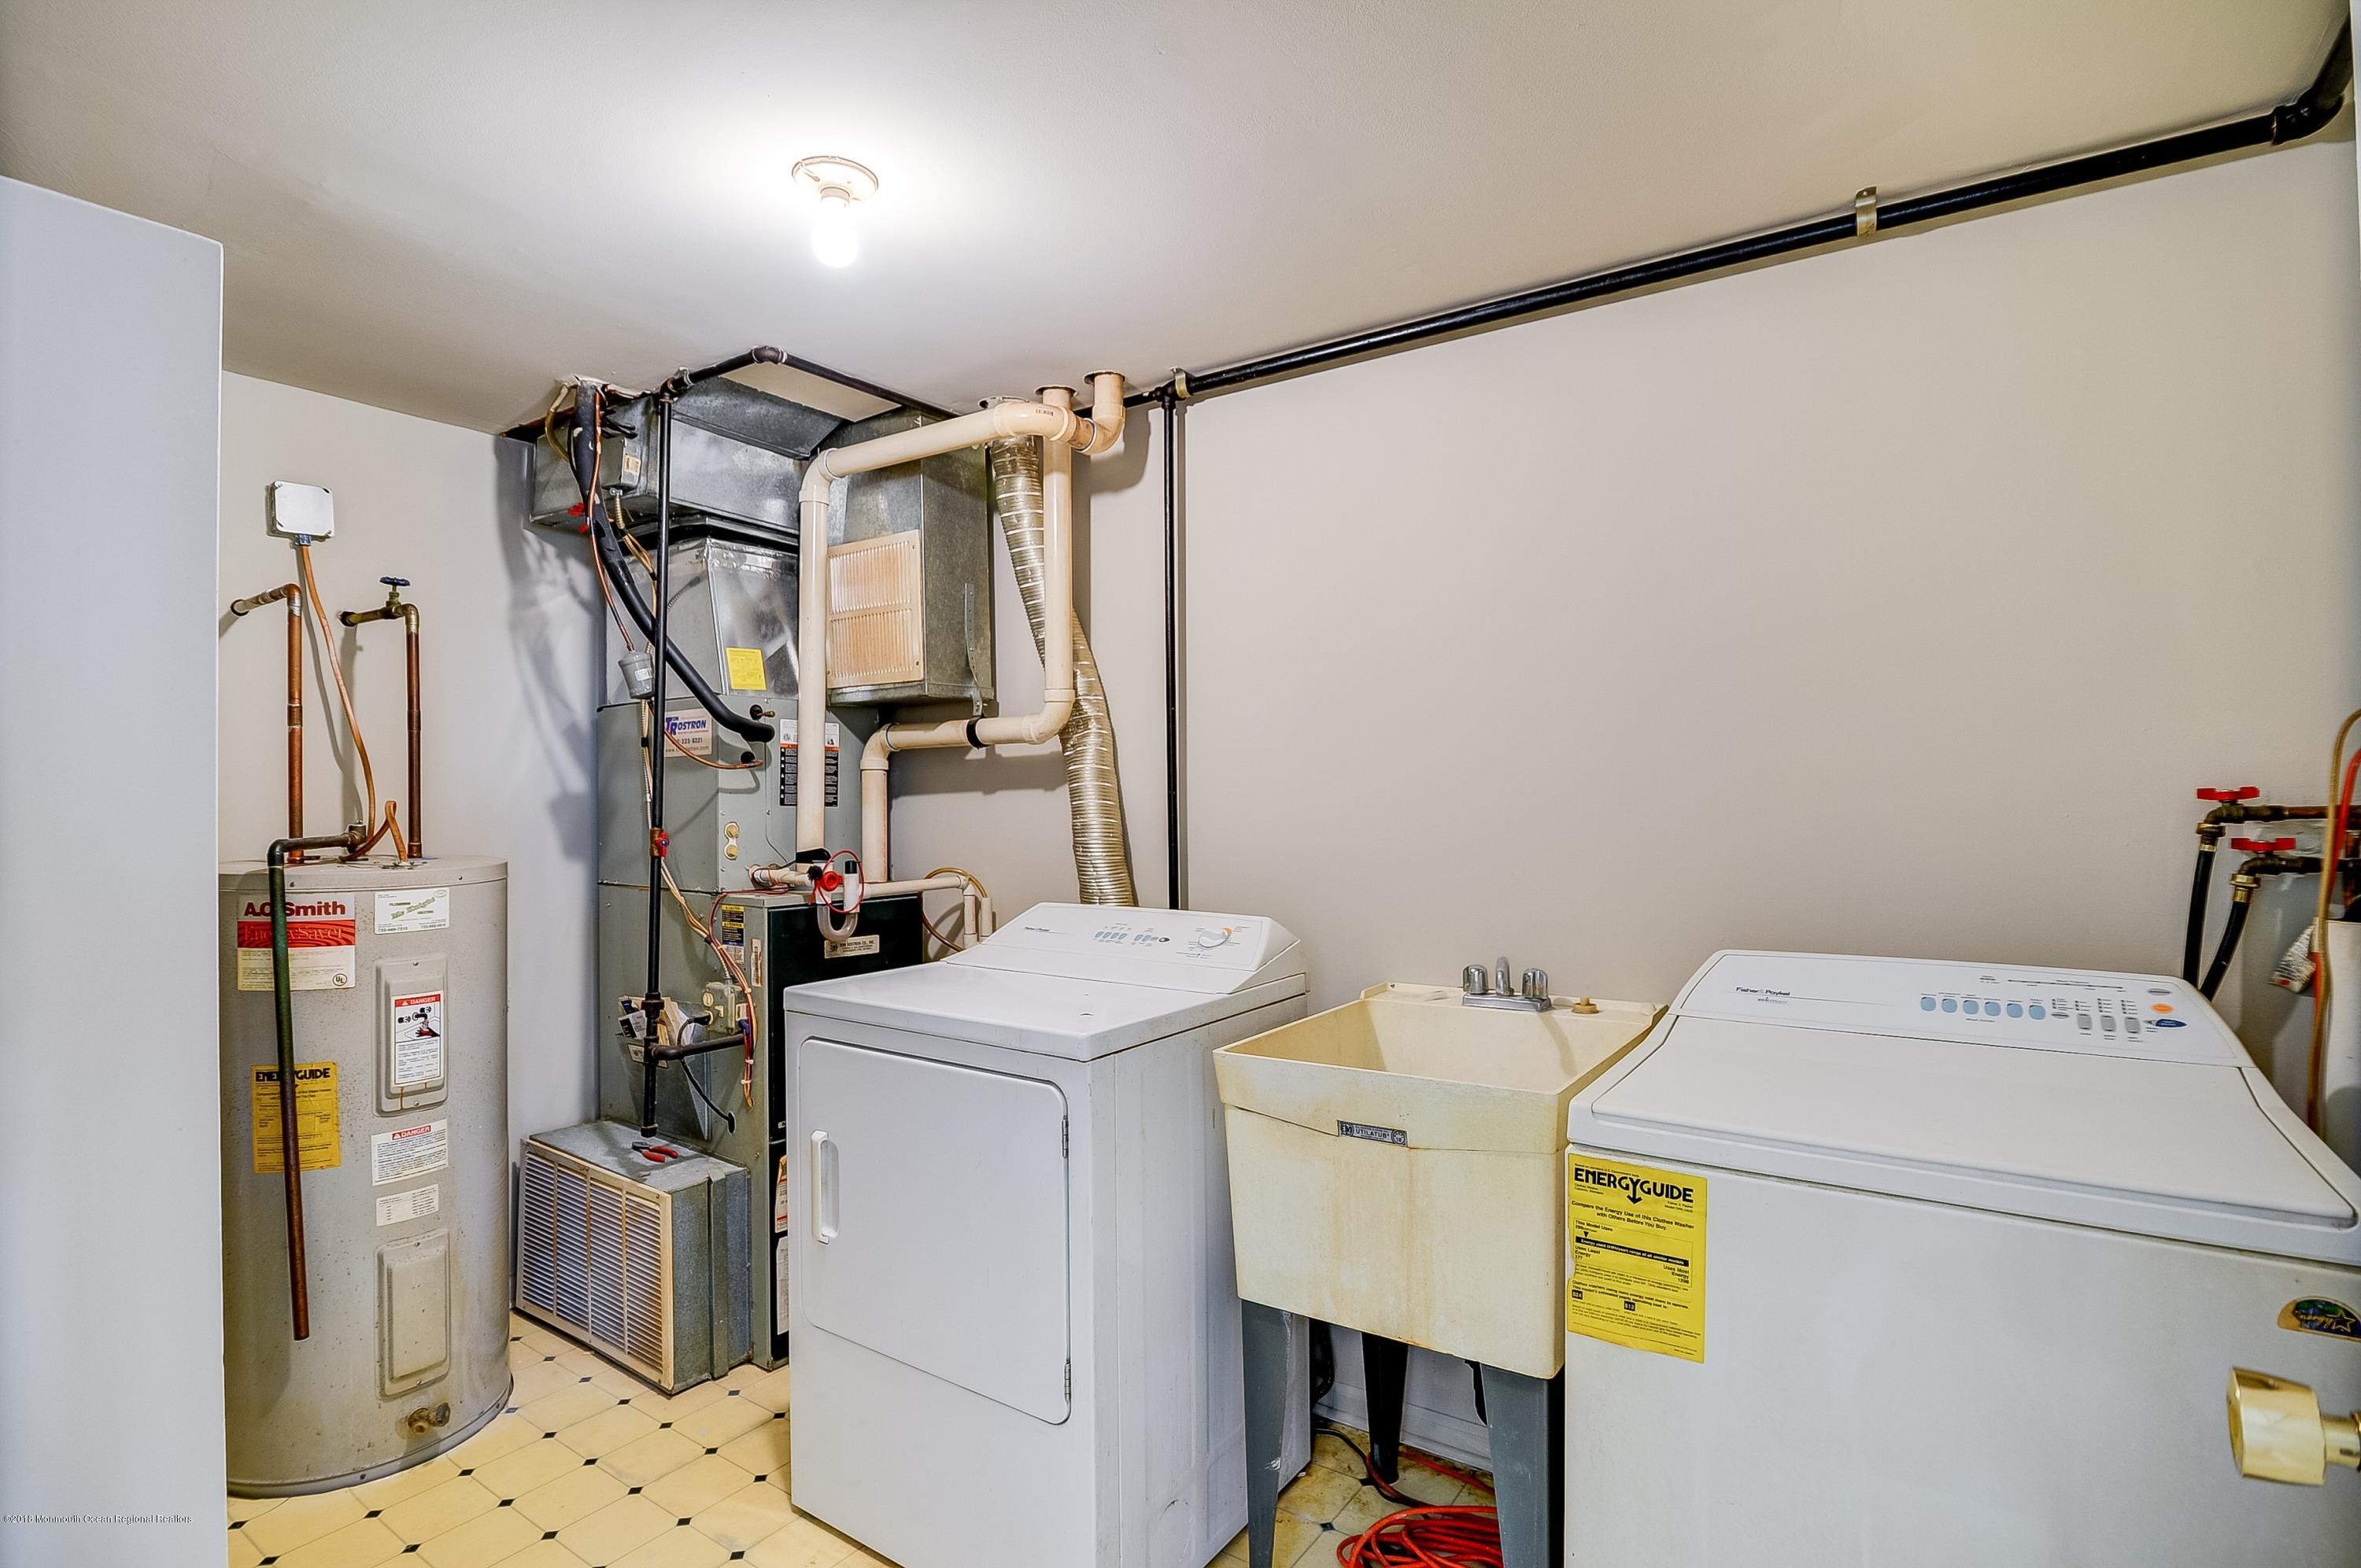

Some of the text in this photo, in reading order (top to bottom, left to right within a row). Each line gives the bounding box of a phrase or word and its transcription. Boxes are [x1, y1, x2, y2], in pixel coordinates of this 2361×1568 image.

[670, 720, 707, 735] ROSTRON
[284, 901, 345, 917] Smith
[256, 1068, 331, 1082] ENEGUIDE
[401, 1126, 430, 1138] DANGER
[1575, 1168, 1694, 1203] ENERGYGUIDE
[1572, 1200, 1594, 1209] Compare
[1653, 1216, 1672, 1225] Clothes
